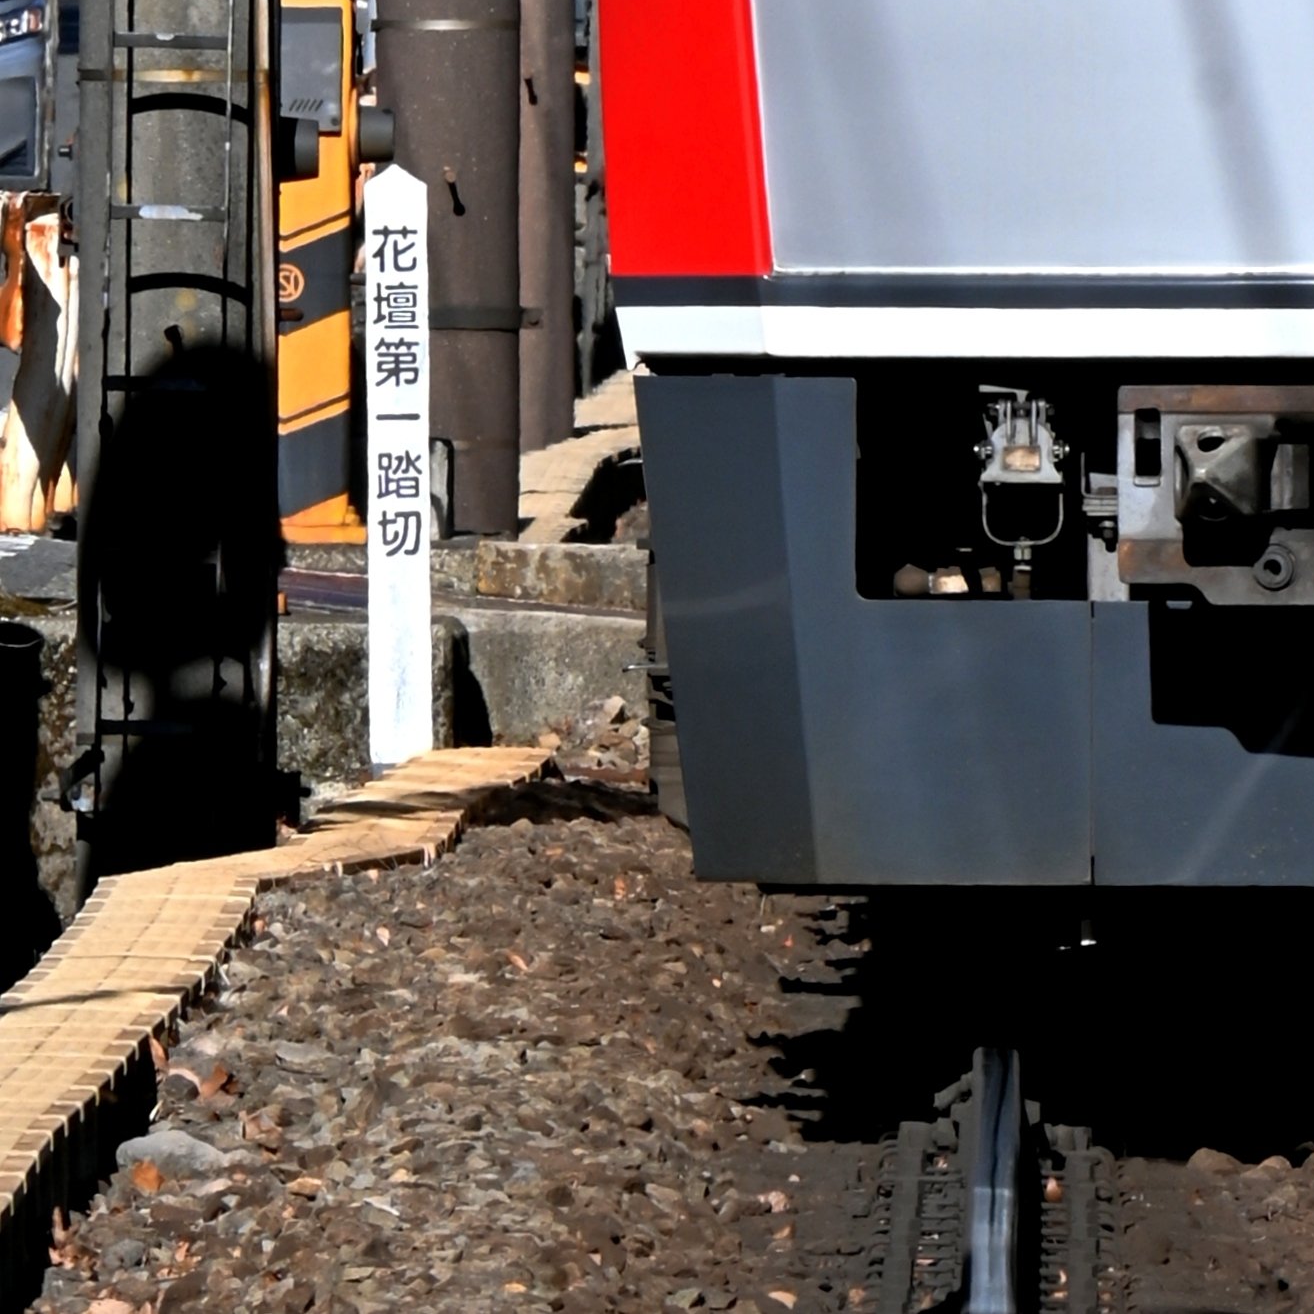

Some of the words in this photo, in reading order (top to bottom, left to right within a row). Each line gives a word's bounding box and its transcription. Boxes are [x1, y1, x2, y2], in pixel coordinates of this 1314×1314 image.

[372, 225, 423, 556] 花壇第一踏切
